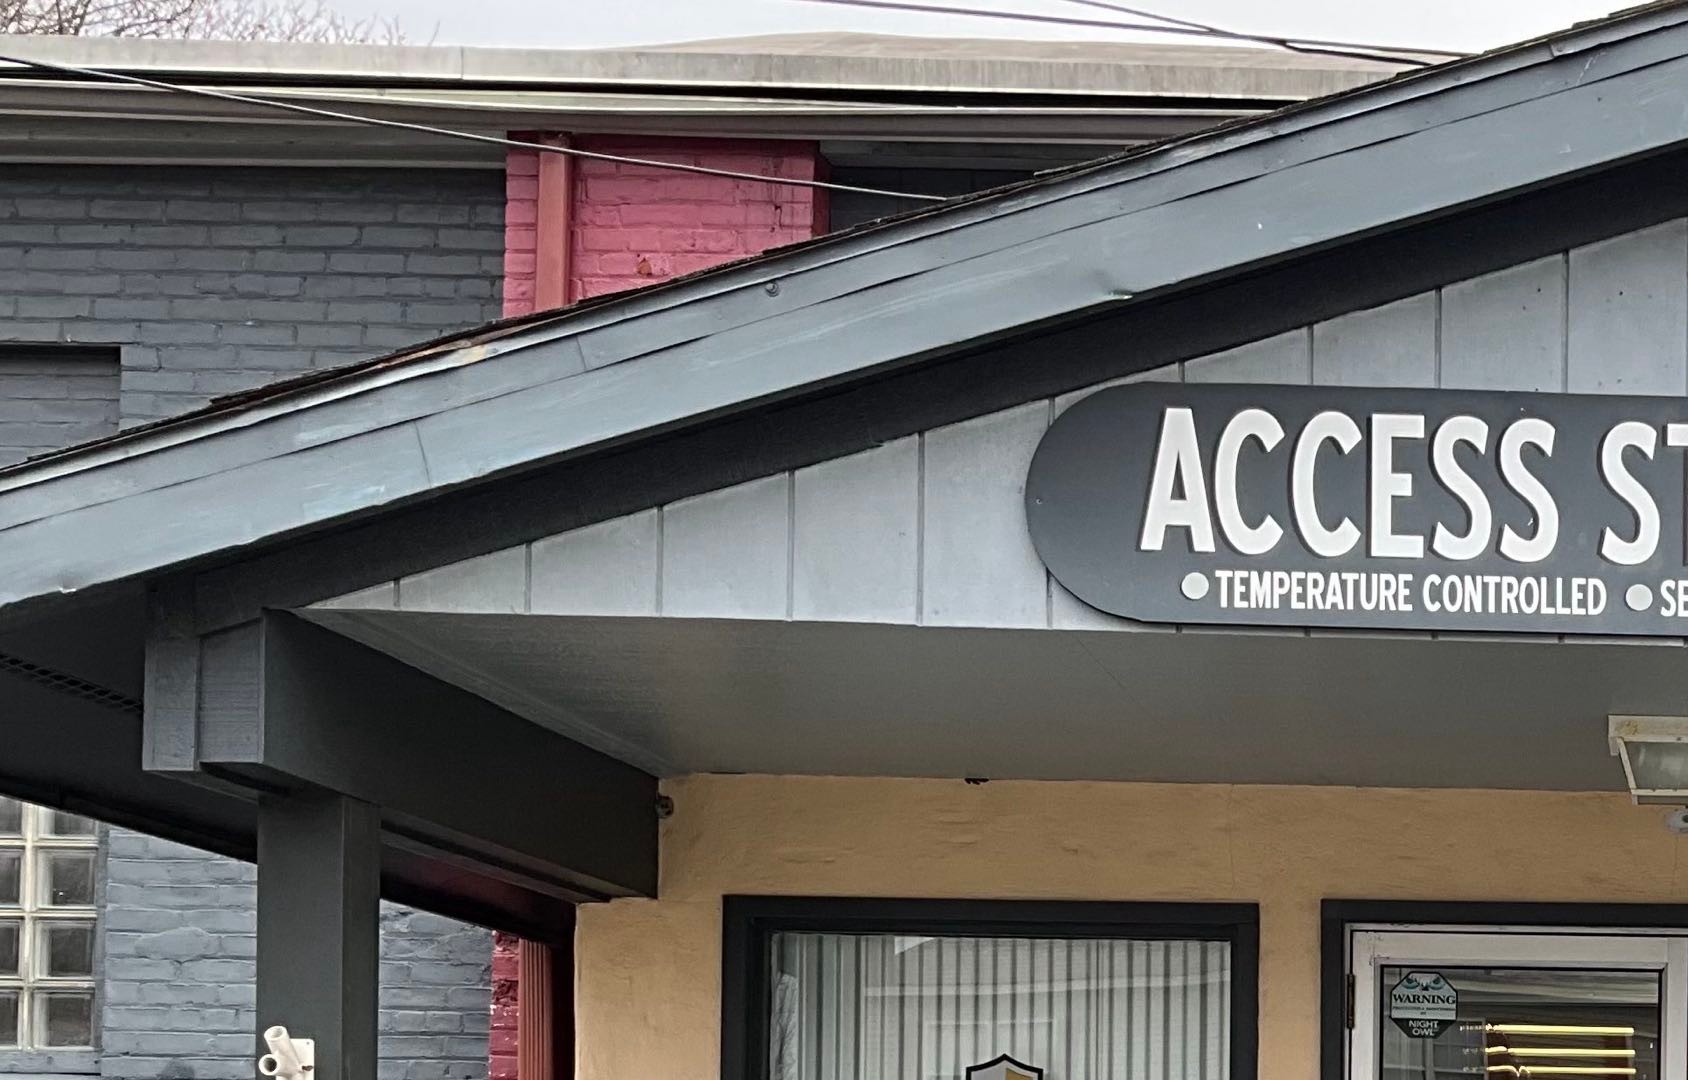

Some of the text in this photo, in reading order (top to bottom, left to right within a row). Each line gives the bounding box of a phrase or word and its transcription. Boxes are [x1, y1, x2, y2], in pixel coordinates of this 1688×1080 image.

[1140, 407, 1559, 563] ACCESS
[1215, 570, 1607, 616] TEMPERATURE CONTROLLED
[1393, 994, 1456, 1004] WARNING
[1408, 1020, 1439, 1028] NIGHT
[1412, 1028, 1434, 1036] OWL
